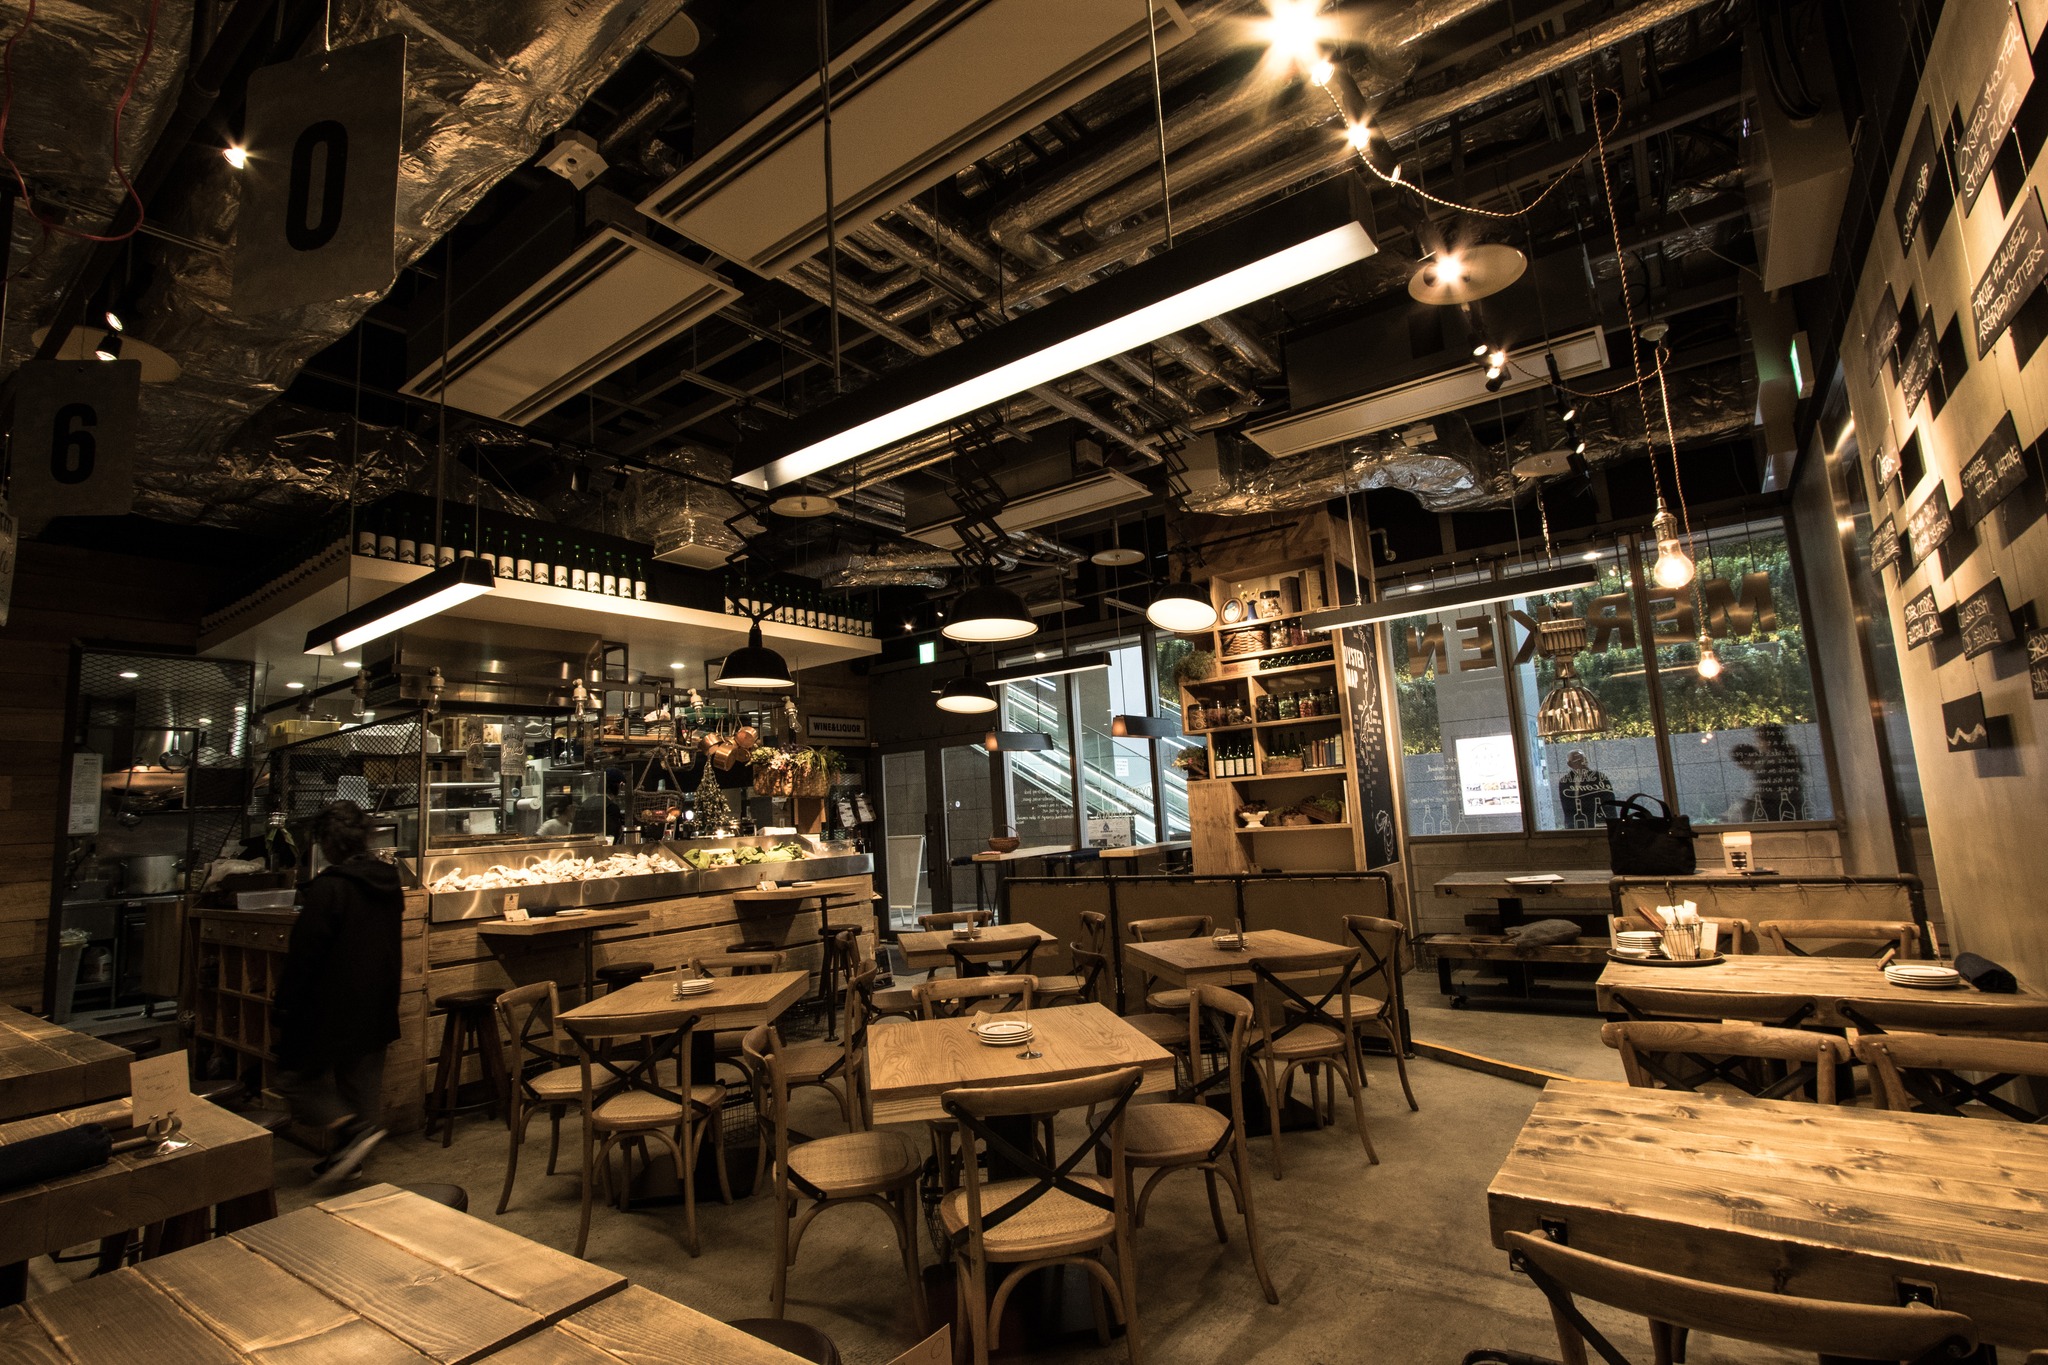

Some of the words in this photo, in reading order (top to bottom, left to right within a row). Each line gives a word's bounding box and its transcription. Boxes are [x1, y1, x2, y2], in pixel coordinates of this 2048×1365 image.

[1959, 104, 1988, 179] OYSTER
[1982, 20, 2021, 108] SHOOTER
[51, 403, 97, 484] 6
[813, 721, 861, 733] WINE&LIQUOR
